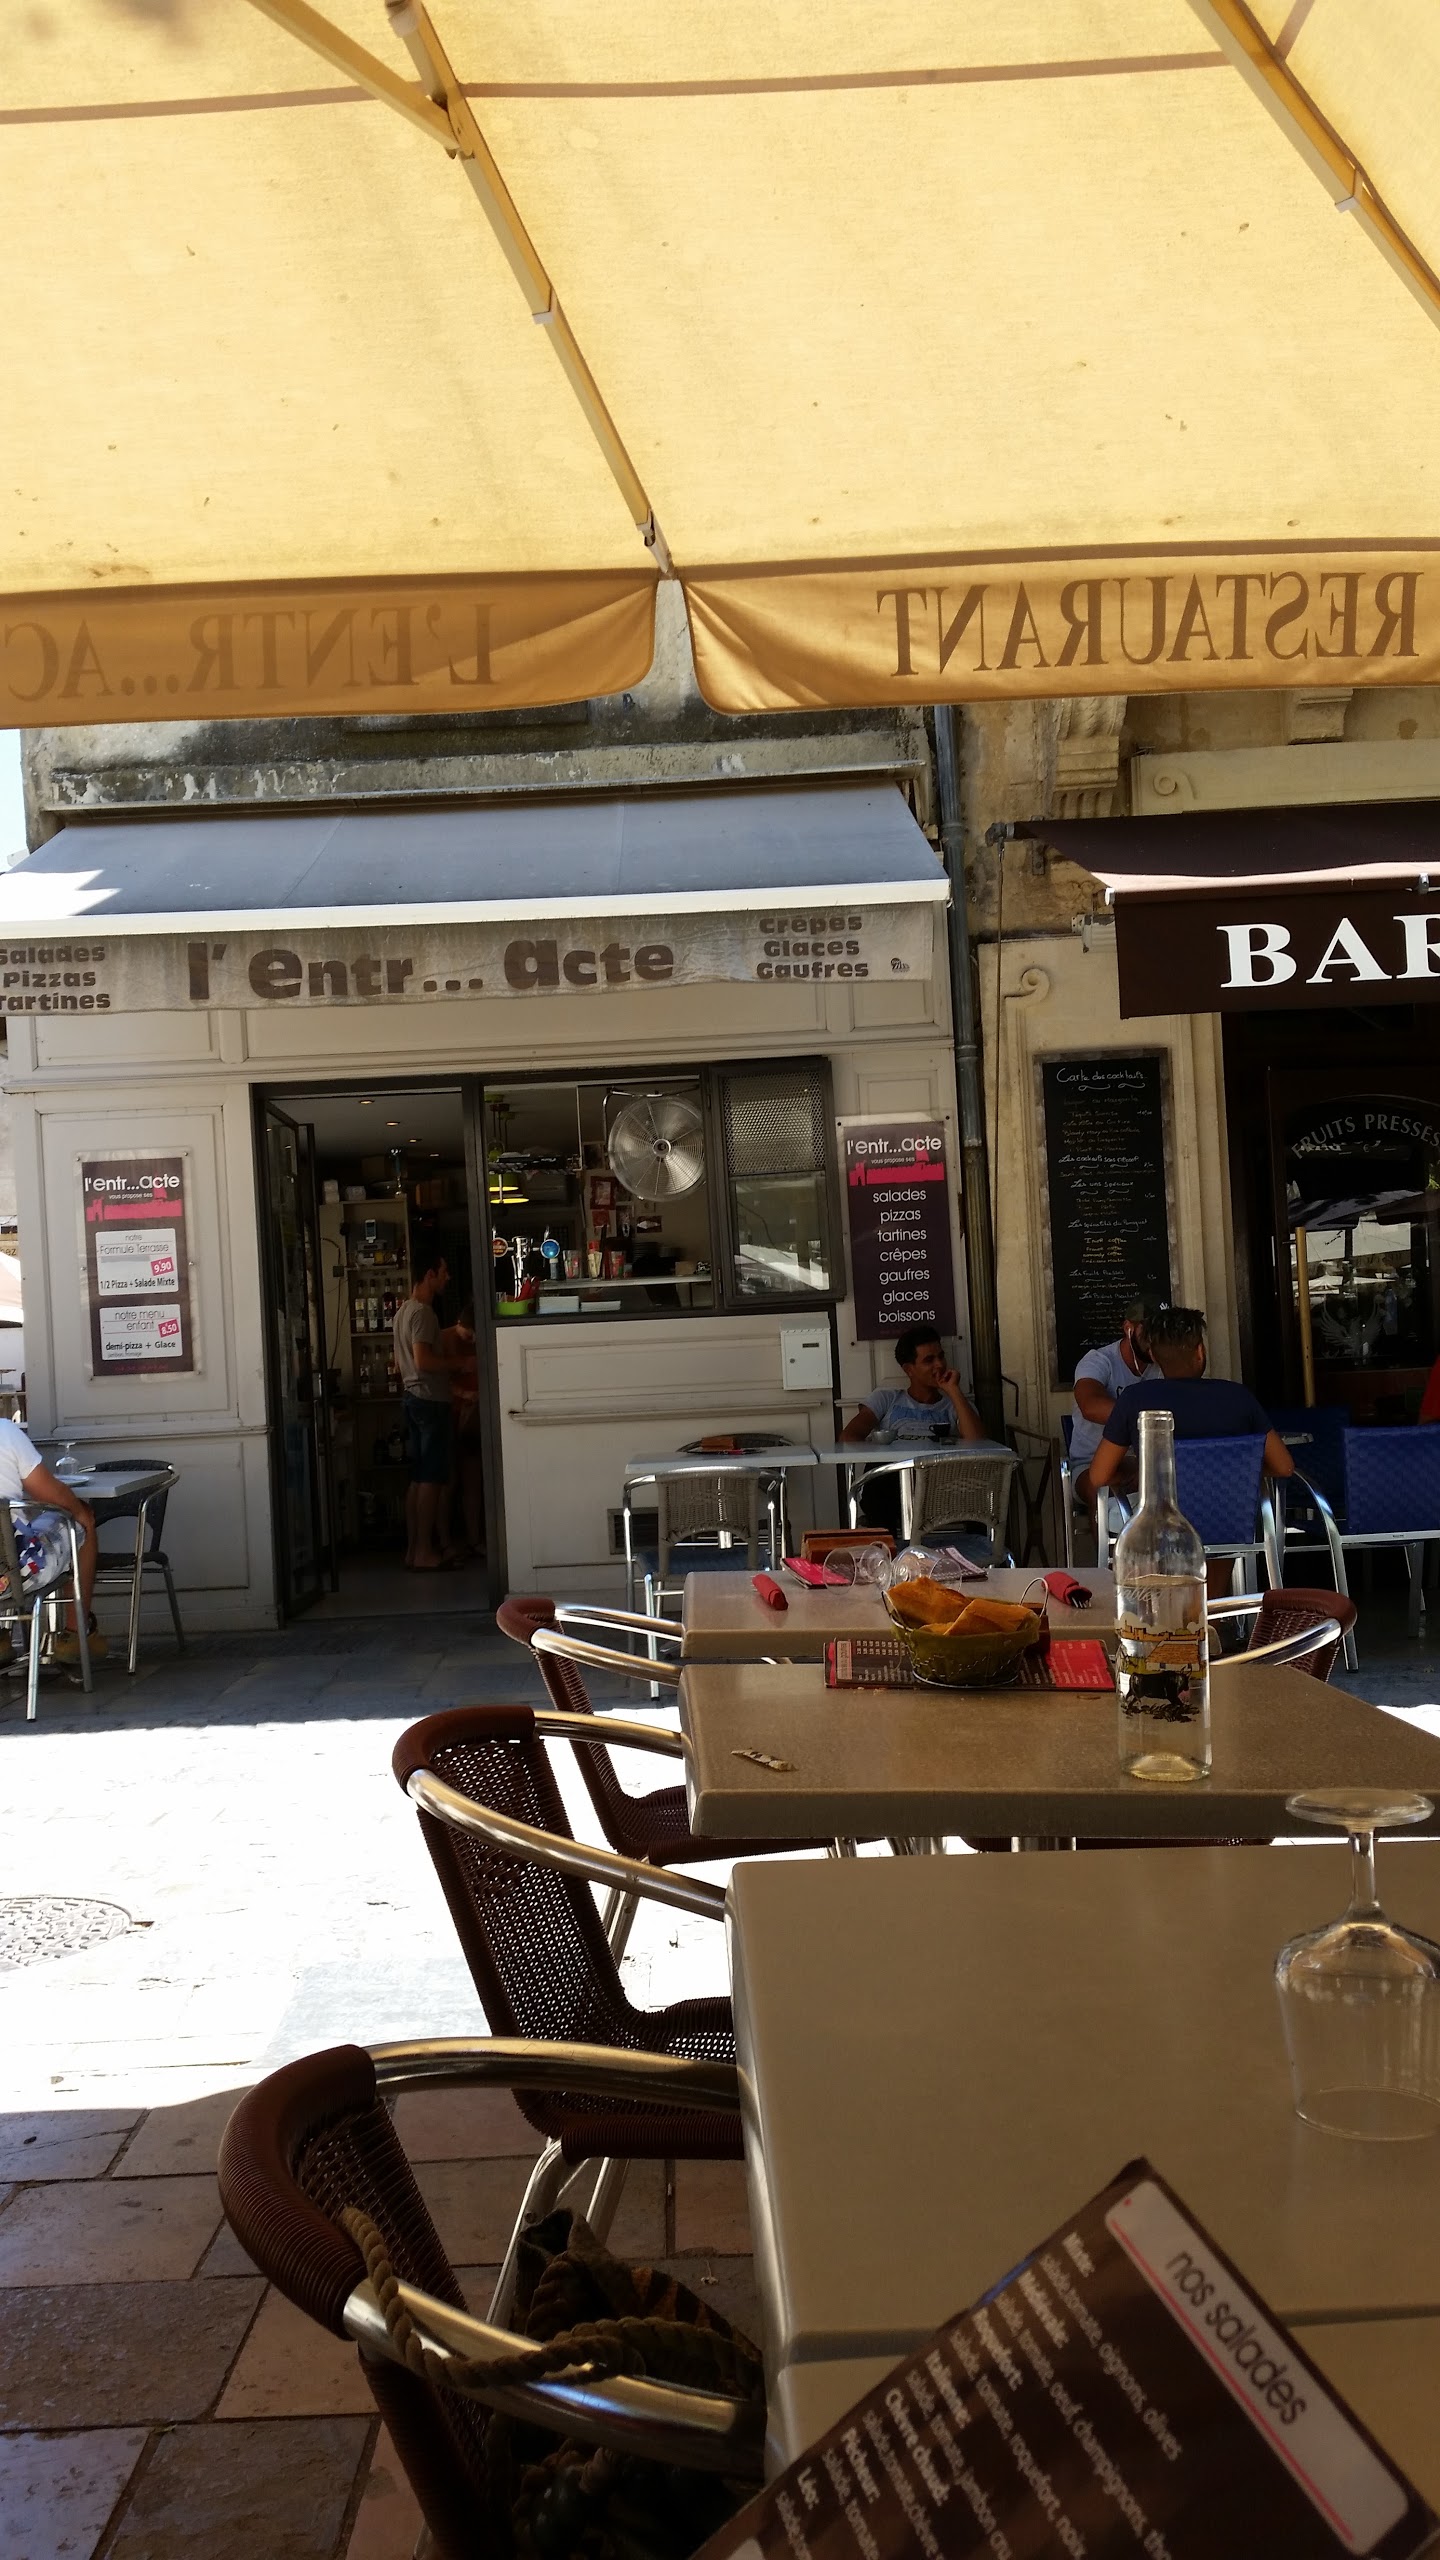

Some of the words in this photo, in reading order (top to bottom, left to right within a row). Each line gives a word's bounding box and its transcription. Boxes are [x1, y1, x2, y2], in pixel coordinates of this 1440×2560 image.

[764, 939, 860, 958] Glaces
[503, 938, 674, 990] acte
[756, 959, 870, 979] Gaufres
[3, 969, 97, 988] Pizzas
[1291, 1116, 1356, 1159] FRUITS
[883, 1157, 905, 1165] propose
[872, 1188, 927, 1204] salades
[880, 1209, 921, 1224] pizzas
[877, 1228, 927, 1243] tartines
[99, 1244, 134, 1255] Formule
[136, 1243, 169, 1253] Terrasse
[879, 1247, 927, 1263] crêpes
[100, 1280, 111, 1289] 1/2
[111, 1280, 128, 1288] Pizza
[134, 1278, 156, 1288] Salade
[157, 1277, 175, 1287] Mixte
[879, 1268, 931, 1285] gaufres
[882, 1289, 930, 1305] glaces
[114, 1310, 137, 1320] notre
[139, 1310, 165, 1319] menu
[878, 1309, 936, 1323] boissons
[126, 1320, 155, 1331] enfant
[105, 1341, 143, 1352] demi-pizza
[154, 1341, 176, 1349] Glace
[1166, 2251, 1217, 2308] nos
[1204, 2300, 1308, 2425] salades
[972, 2307, 1022, 2390] Roquefort:
[923, 2350, 970, 2428] Italienne:
[1097, 2341, 1147, 2413] oignons,
[1140, 2406, 1183, 2461] olives
[883, 2387, 918, 2448] Chèvre
[912, 2445, 947, 2505] chaud:
[1008, 2434, 1060, 2520] roquefort,
[1071, 2417, 1146, 2538] champignons,
[797, 2467, 819, 2509] Léo:
[955, 2467, 996, 2533] jambon
